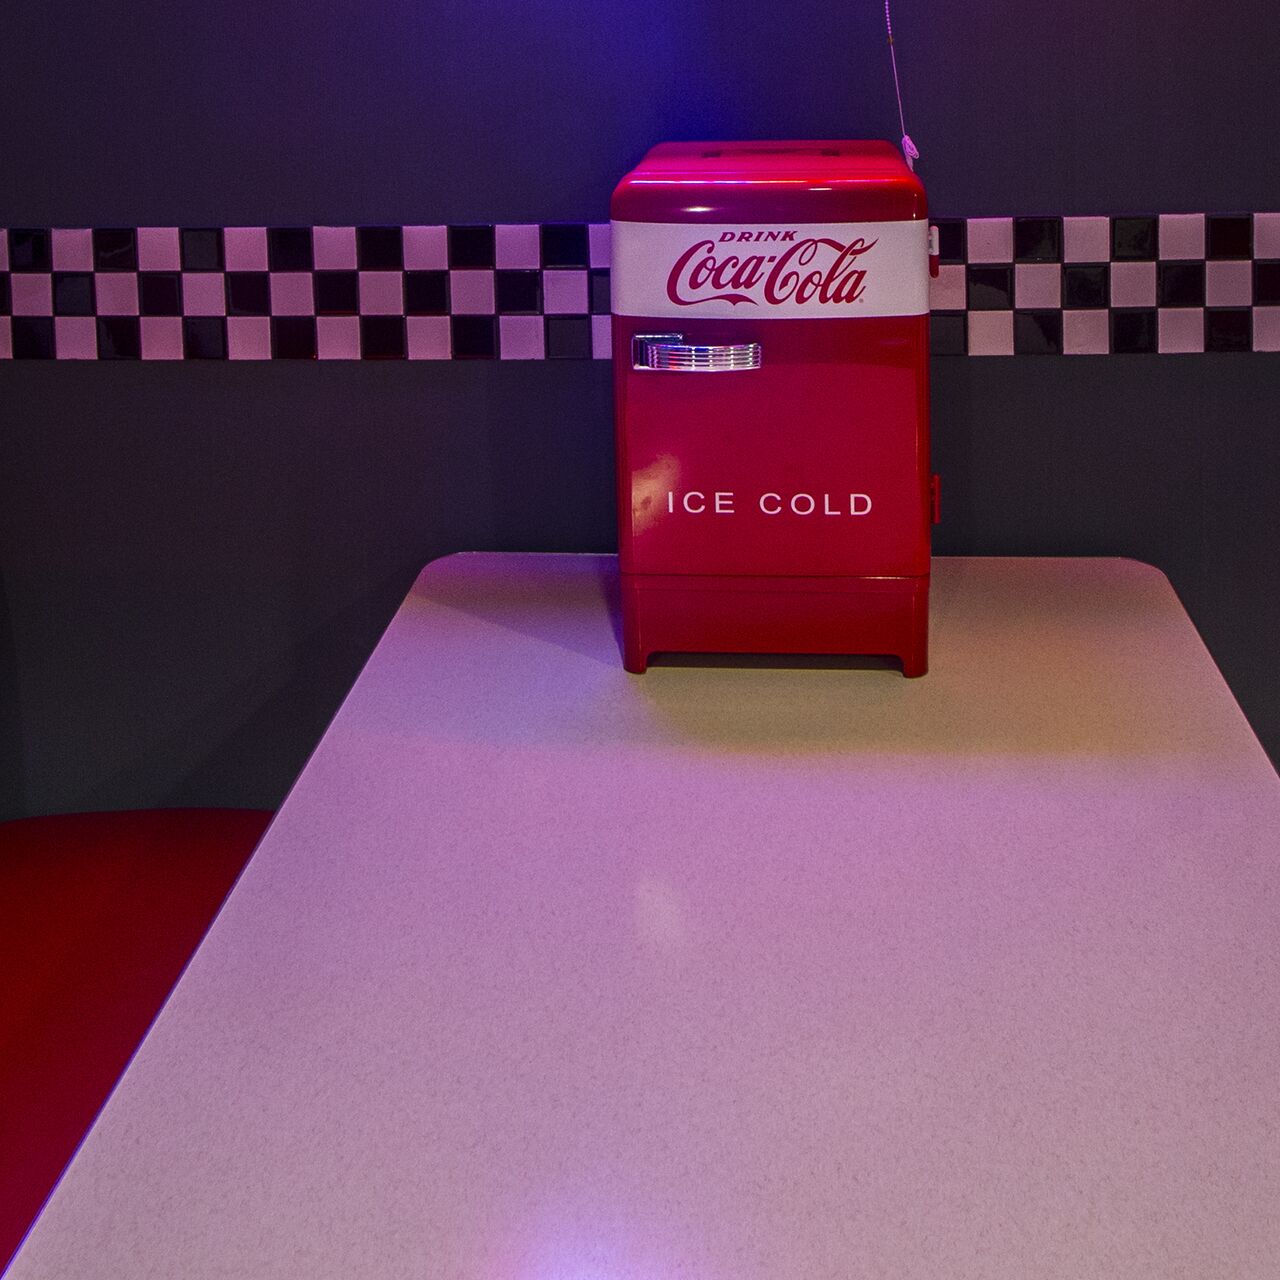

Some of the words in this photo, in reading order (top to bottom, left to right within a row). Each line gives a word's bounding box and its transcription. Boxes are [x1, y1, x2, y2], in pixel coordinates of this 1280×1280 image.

[718, 230, 798, 243] DRINK
[666, 238, 880, 307] Coca-Cola
[668, 491, 736, 514] ICE
[760, 492, 873, 516] COLD
